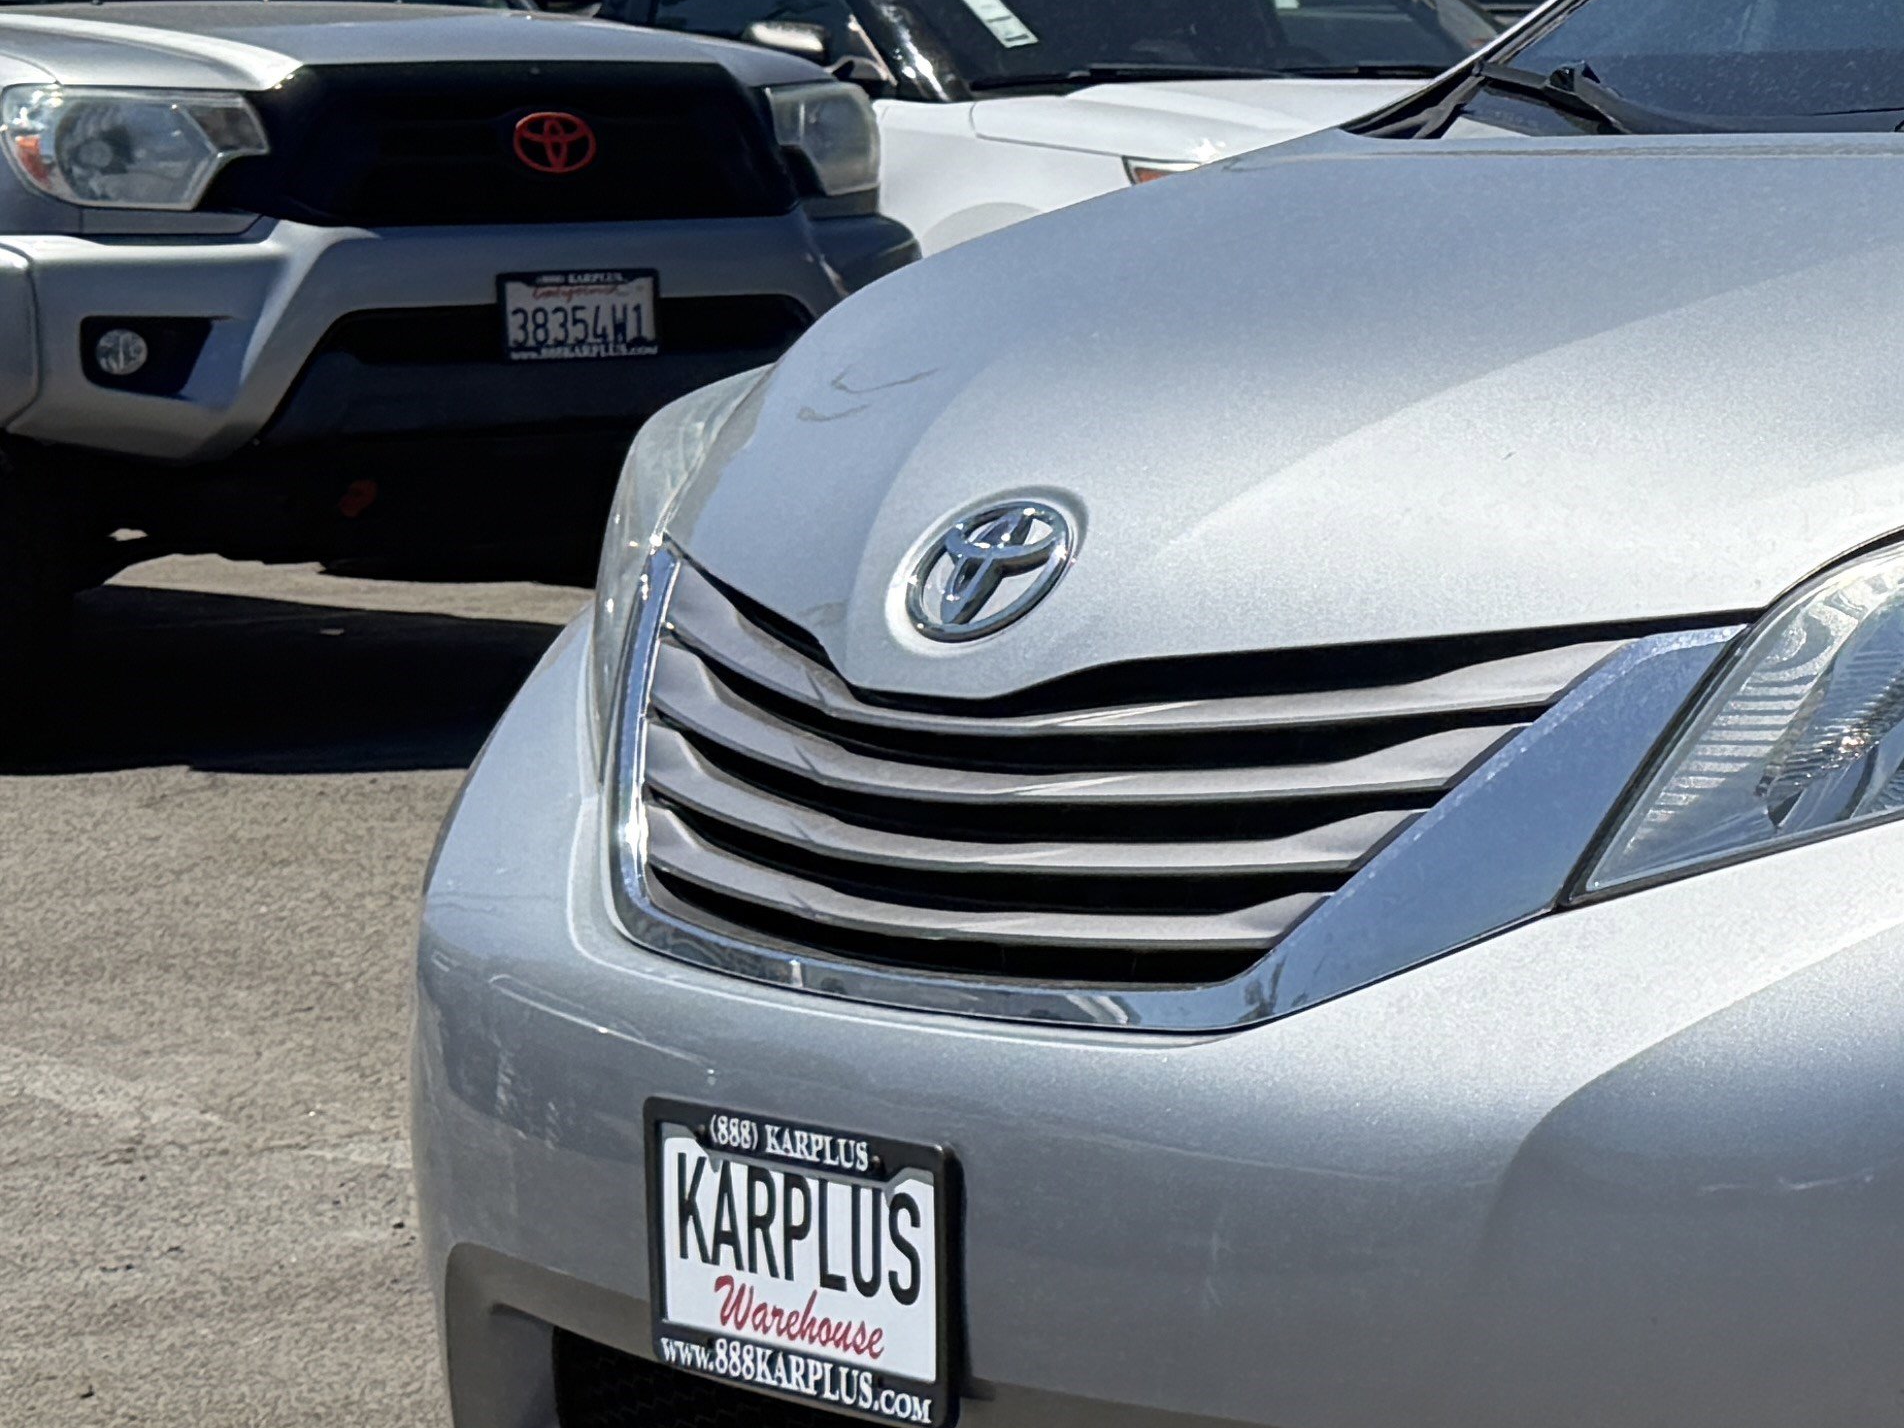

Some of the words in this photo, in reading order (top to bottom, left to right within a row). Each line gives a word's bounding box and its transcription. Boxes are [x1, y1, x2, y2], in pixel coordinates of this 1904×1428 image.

[709, 1114, 759, 1151] (888)
[765, 1124, 870, 1173] KARPLUS
[677, 1151, 922, 1306] KARPLUS
[714, 1274, 886, 1360] Warehouse
